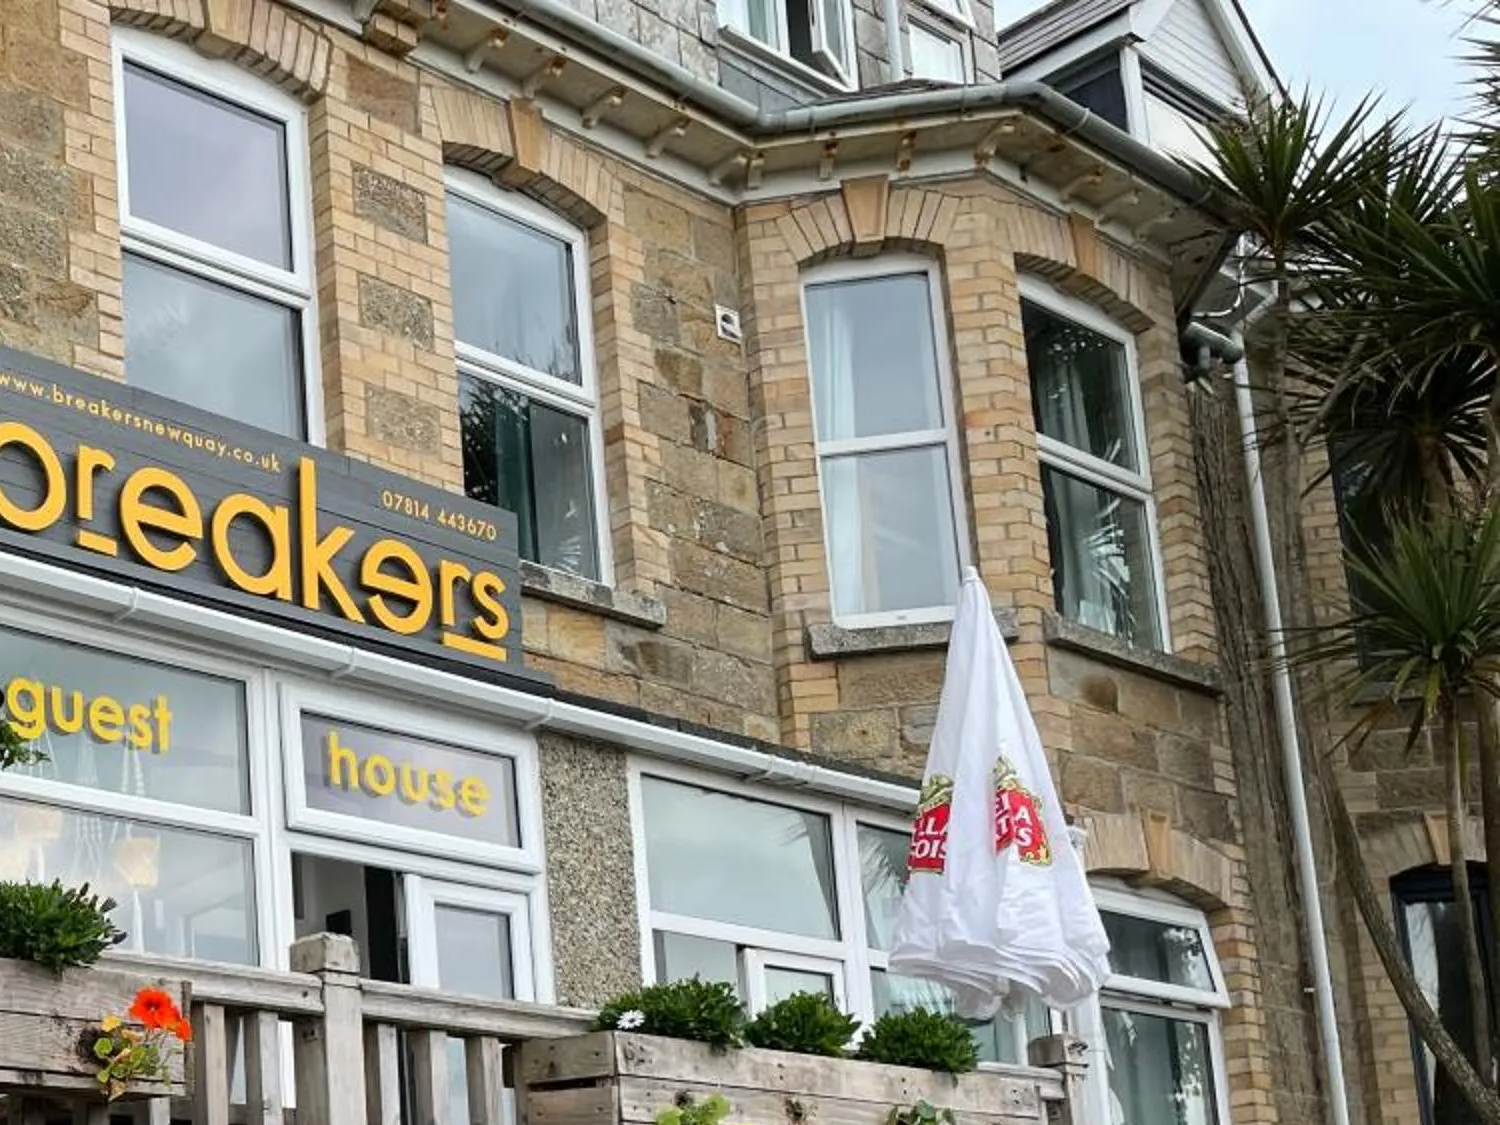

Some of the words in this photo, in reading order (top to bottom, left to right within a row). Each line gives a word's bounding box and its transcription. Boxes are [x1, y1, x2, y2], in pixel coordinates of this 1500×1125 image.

[382, 489, 430, 520] 07814
[436, 506, 498, 541] 443670
[6, 676, 173, 752] guest
[327, 726, 491, 817] house
